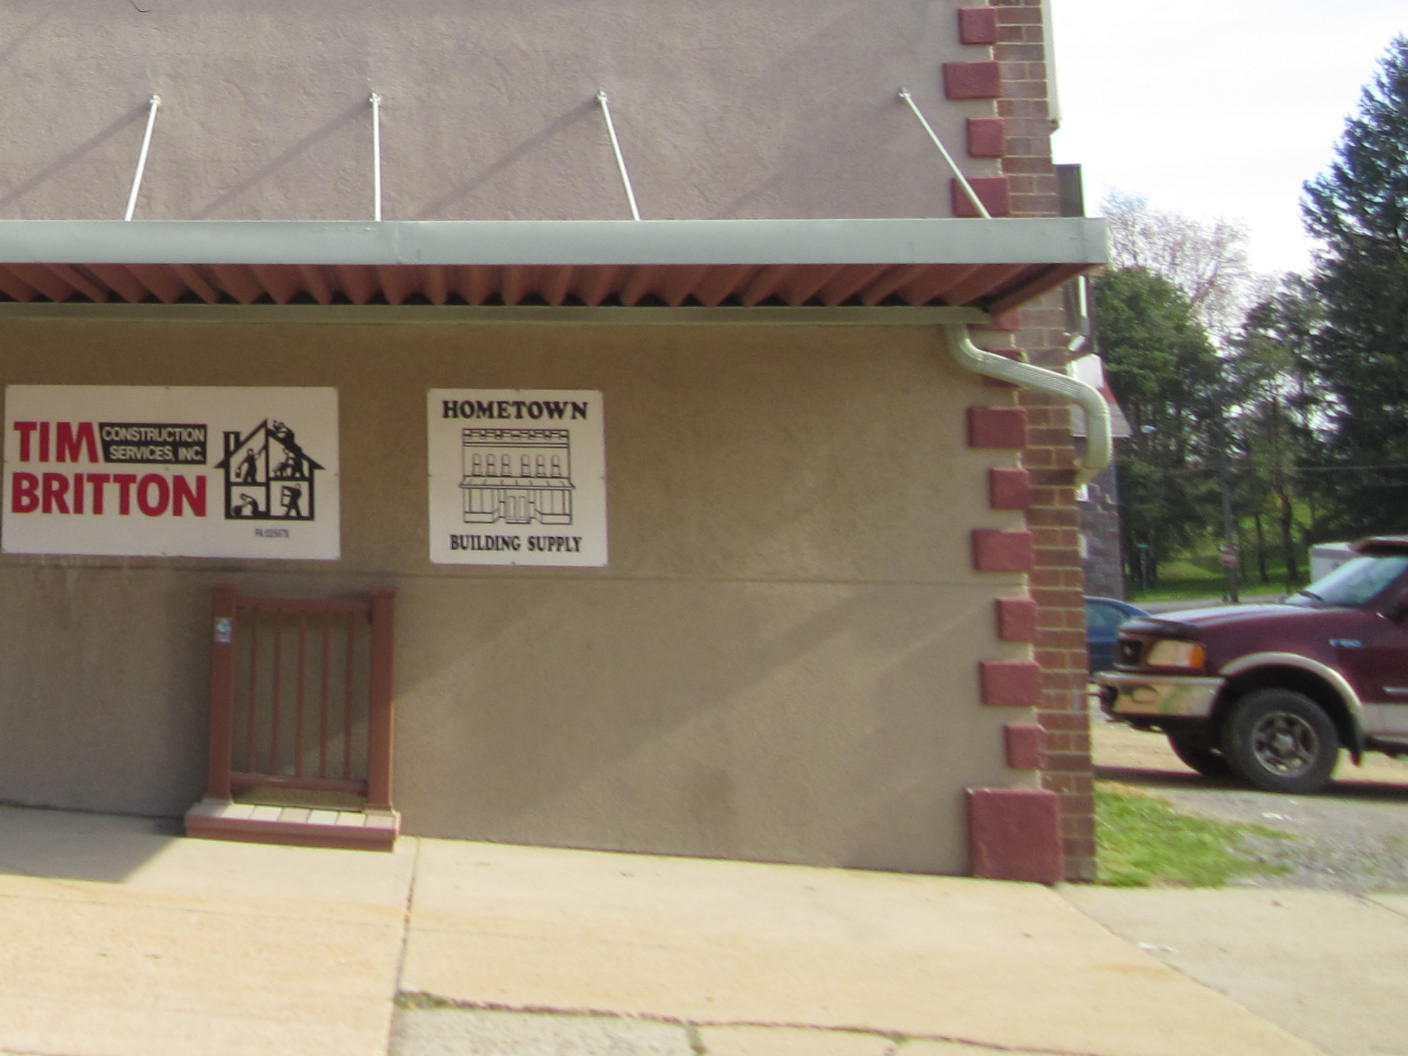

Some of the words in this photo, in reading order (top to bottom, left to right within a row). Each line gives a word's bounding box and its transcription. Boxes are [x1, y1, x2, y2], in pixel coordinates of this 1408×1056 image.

[441, 400, 588, 419] HOMETOWN
[13, 421, 99, 463] TIM
[102, 426, 204, 442] CONSTRUCTION
[109, 446, 175, 462] SERVICES,
[178, 447, 204, 462] INC.
[11, 472, 207, 518] BRITTON
[449, 534, 521, 551] BUILDING
[527, 536, 583, 553] SUPPLY
